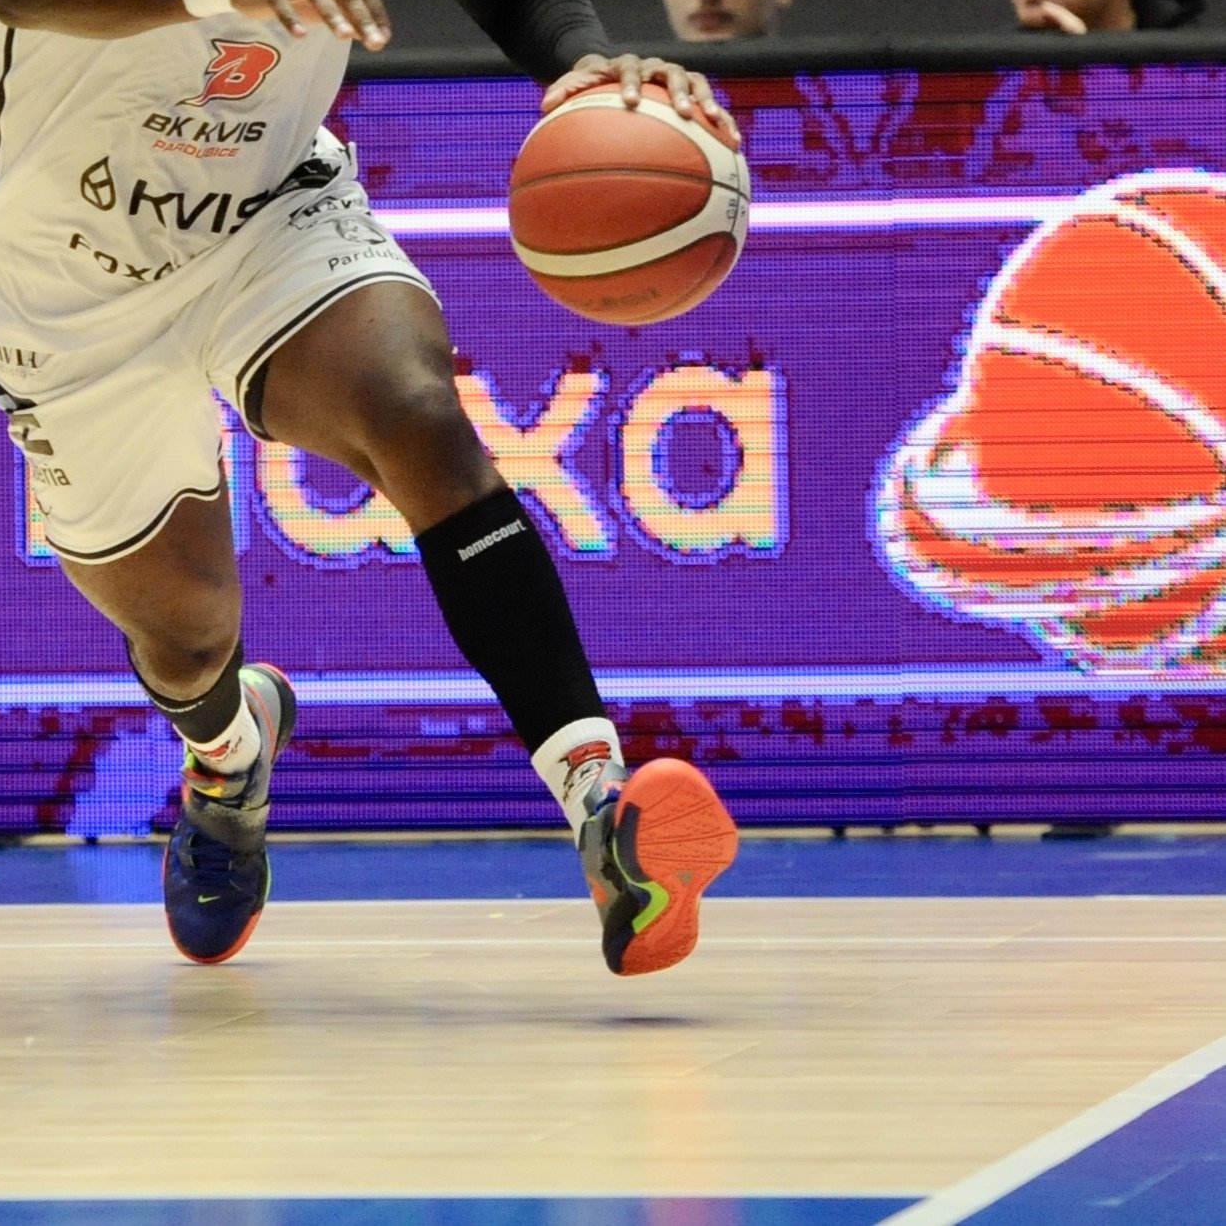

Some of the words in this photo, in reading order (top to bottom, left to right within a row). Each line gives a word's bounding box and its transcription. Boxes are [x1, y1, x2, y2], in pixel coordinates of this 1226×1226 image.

[142, 113, 194, 137] BK
[193, 121, 267, 144] KVIS
[152, 139, 240, 159] PARDUBICE
[457, 518, 527, 562] homecourt
